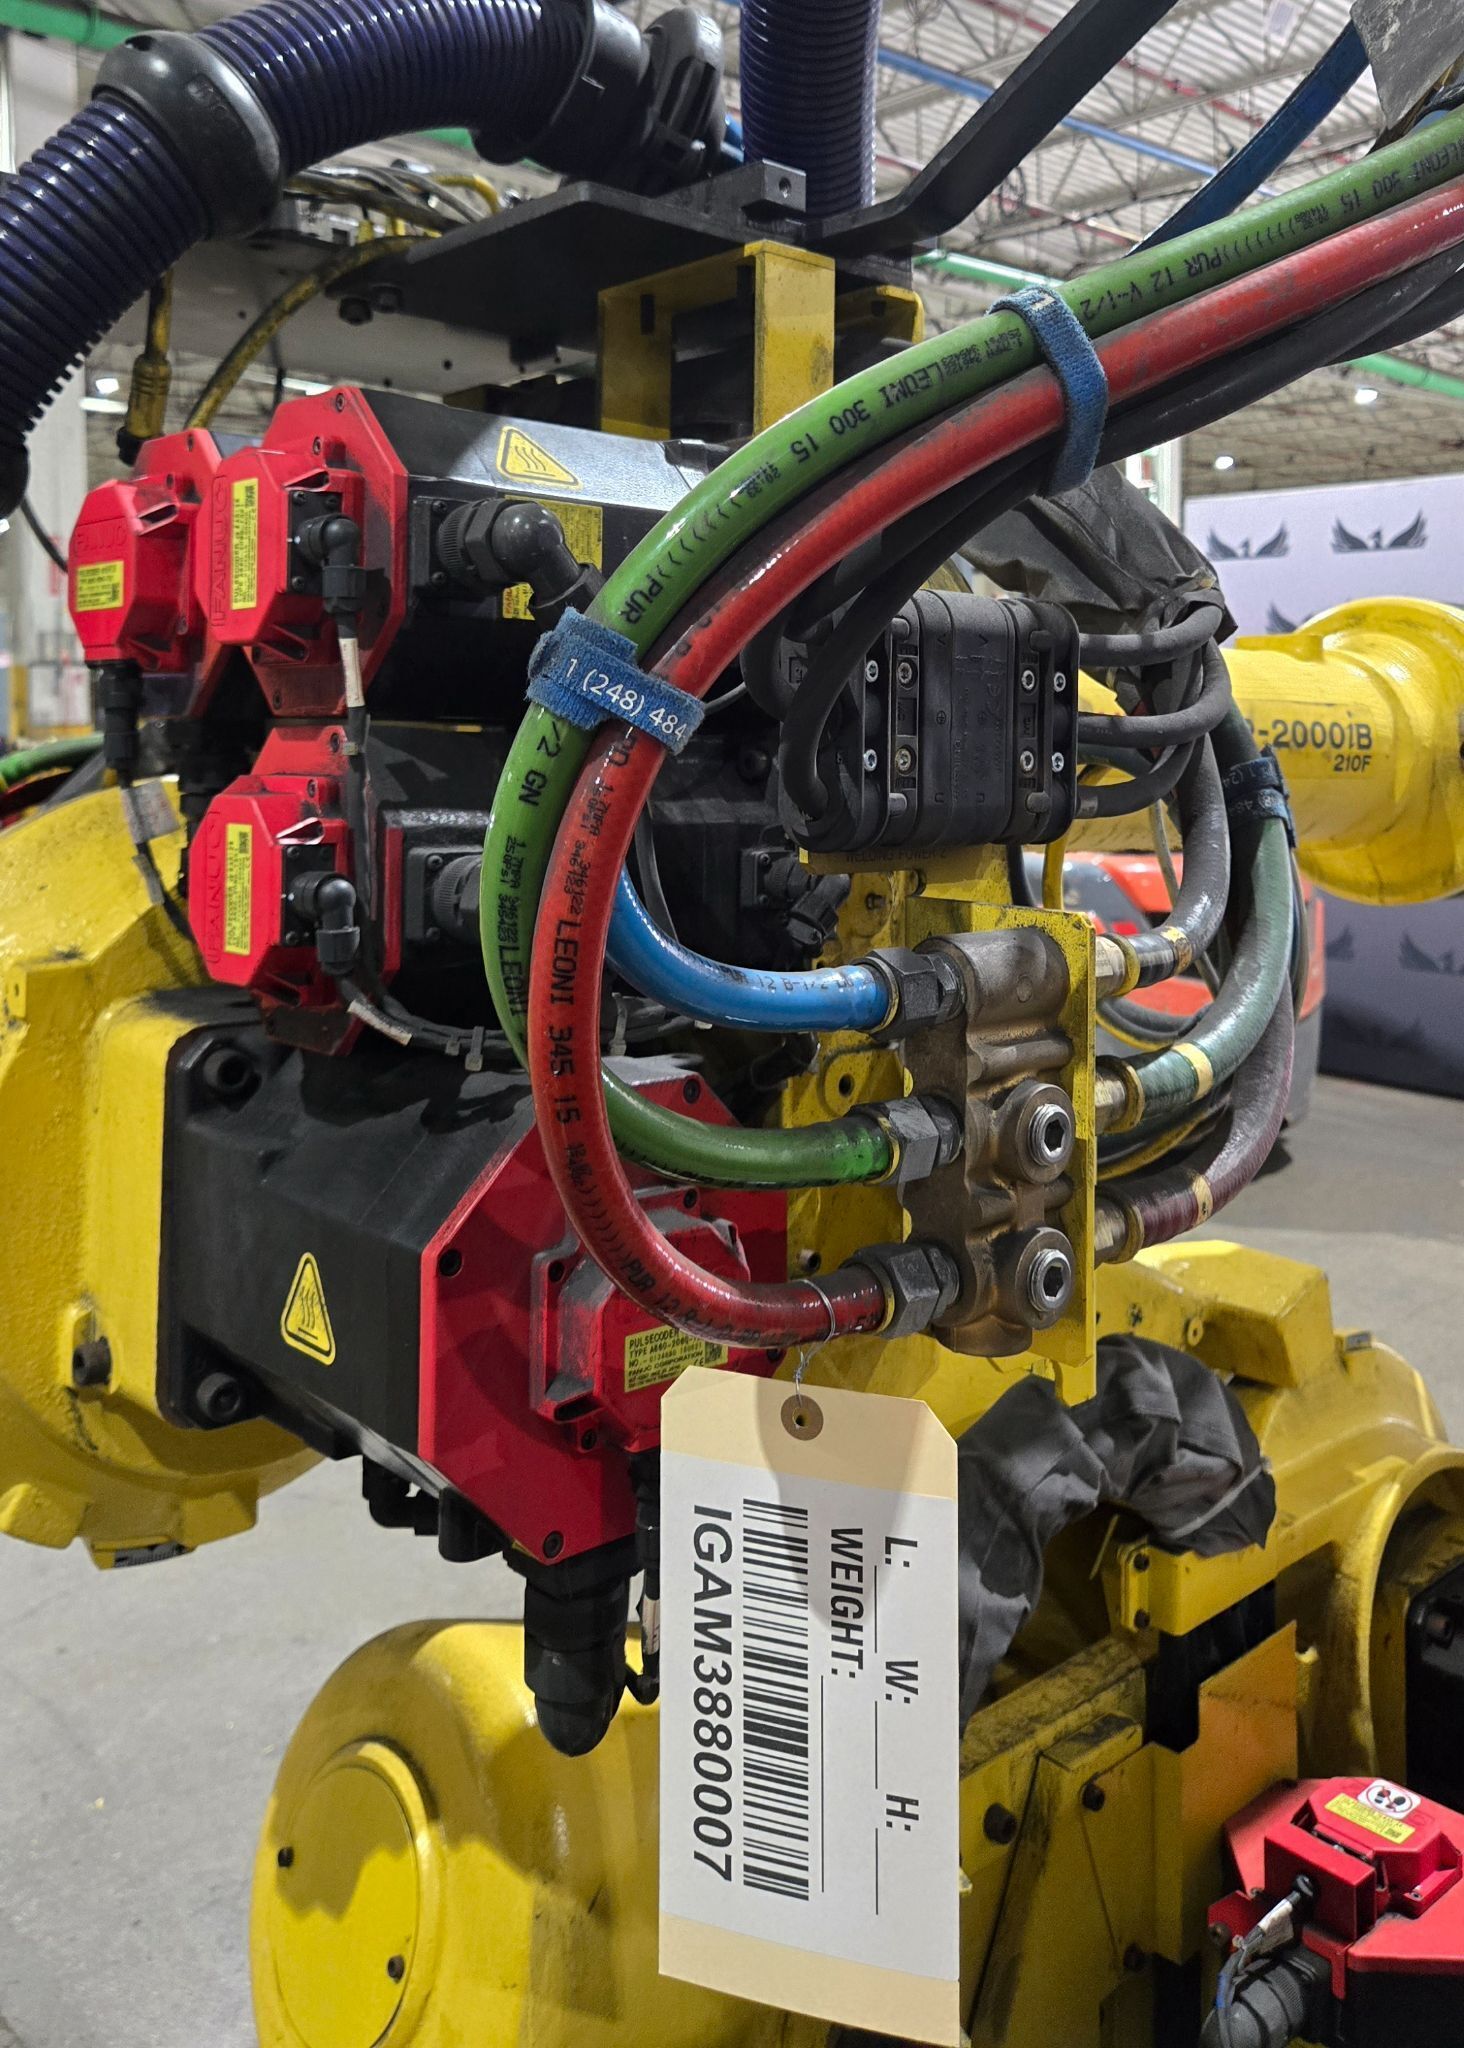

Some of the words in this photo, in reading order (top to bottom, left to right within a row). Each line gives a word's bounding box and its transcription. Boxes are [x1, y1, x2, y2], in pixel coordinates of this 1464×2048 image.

[1150, 265, 1175, 294] 12
[1183, 251, 1223, 280] PUR
[878, 361, 943, 409] LEONI
[829, 399, 871, 436] 300
[789, 433, 820, 464] 15
[619, 573, 664, 625] PUR
[565, 658, 578, 678] 1
[582, 668, 645, 717] (248)
[649, 707, 688, 741] 484
[1245, 713, 1373, 750] -2000iB
[1333, 754, 1373, 773] 210F
[517, 769, 548, 807] GN
[570, 859, 591, 915] 346122
[497, 944, 528, 1016] LEONI
[551, 919, 581, 1006] LEONI
[757, 974, 777, 991] 12
[548, 1024, 575, 1077] 345
[554, 1095, 581, 1124] 15
[620, 1257, 657, 1293] PUR
[628, 1328, 680, 1350] PULSECODER
[629, 1345, 648, 1358] TYPE
[885, 1535, 919, 1568] L:
[830, 1527, 864, 1679] WEIGHT:
[693, 1504, 733, 1882] IGAM3880007
[885, 1660, 919, 1704] W:
[885, 1793, 920, 1832] H:
